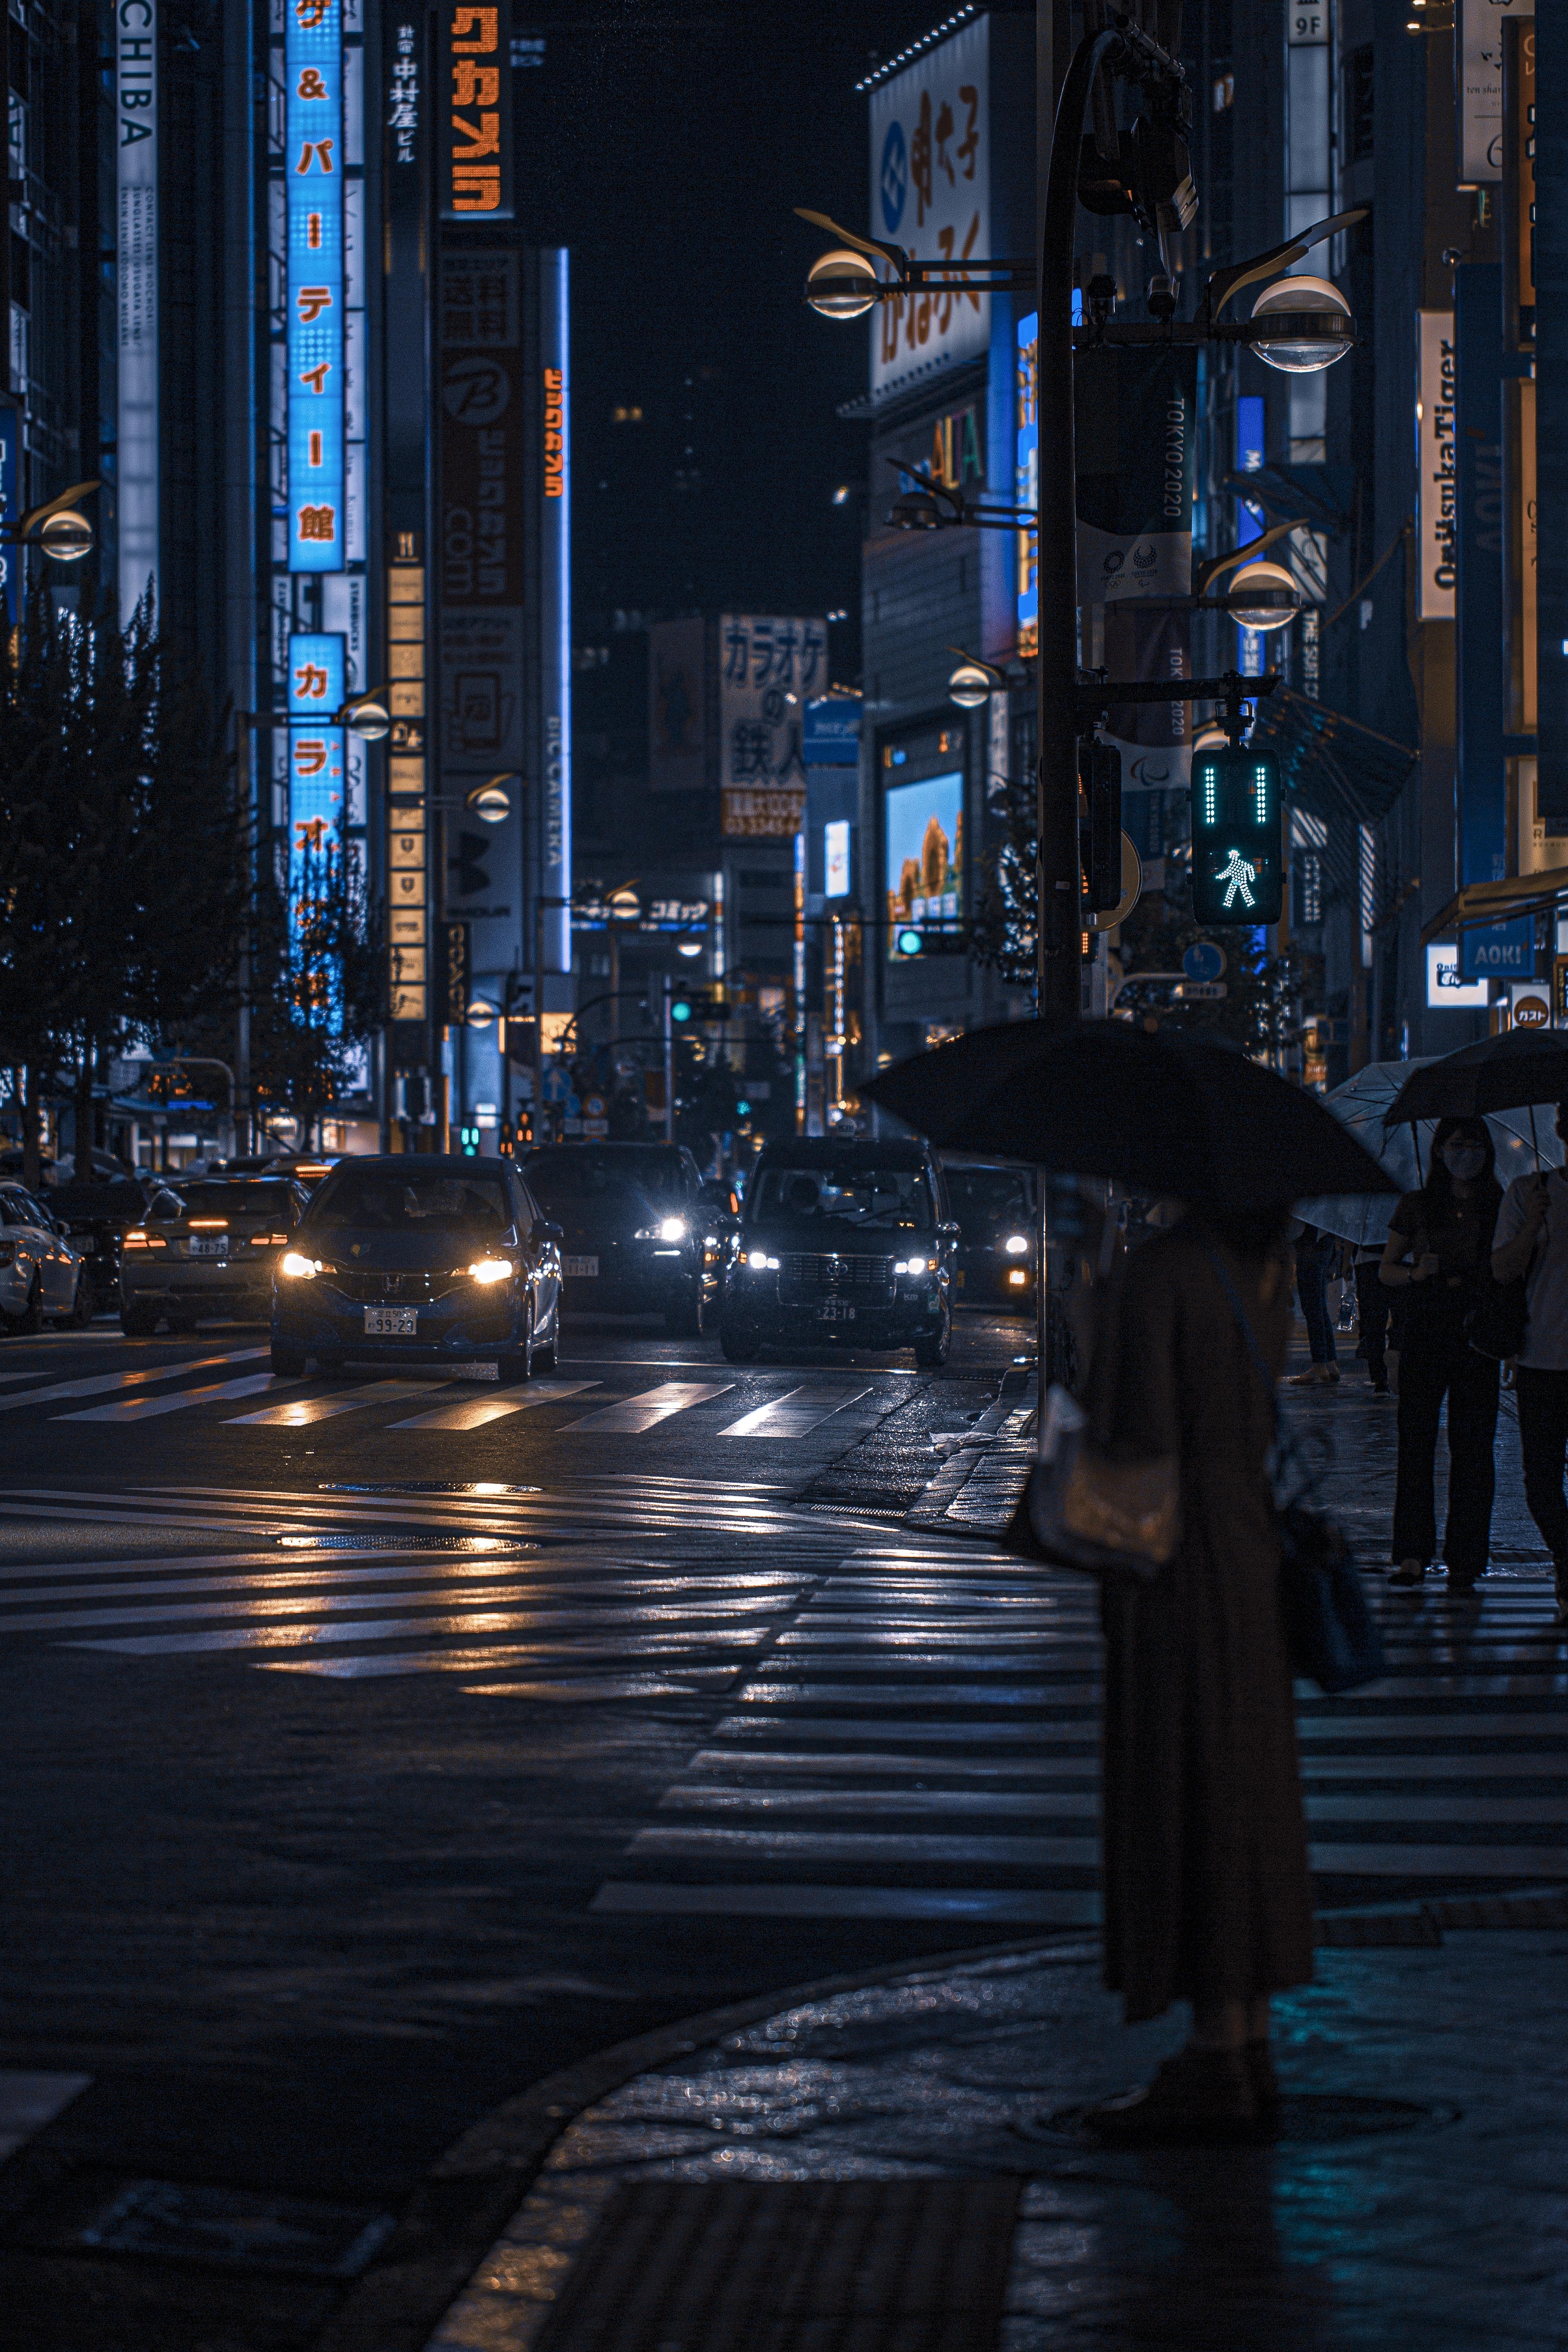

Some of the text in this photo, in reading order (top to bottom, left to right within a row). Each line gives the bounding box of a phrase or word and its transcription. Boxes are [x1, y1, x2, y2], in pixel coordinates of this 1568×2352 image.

[1296, 16, 1320, 36] 9F
[1163, 397, 1185, 517] TOKYO 2020
[350, 581, 359, 652] STARBUCKS
[724, 624, 823, 689] カラオケ
[1474, 945, 1522, 965] AOKI
[1518, 1010, 1546, 1022] ガスト
[823, 1307, 856, 1320] 23-18
